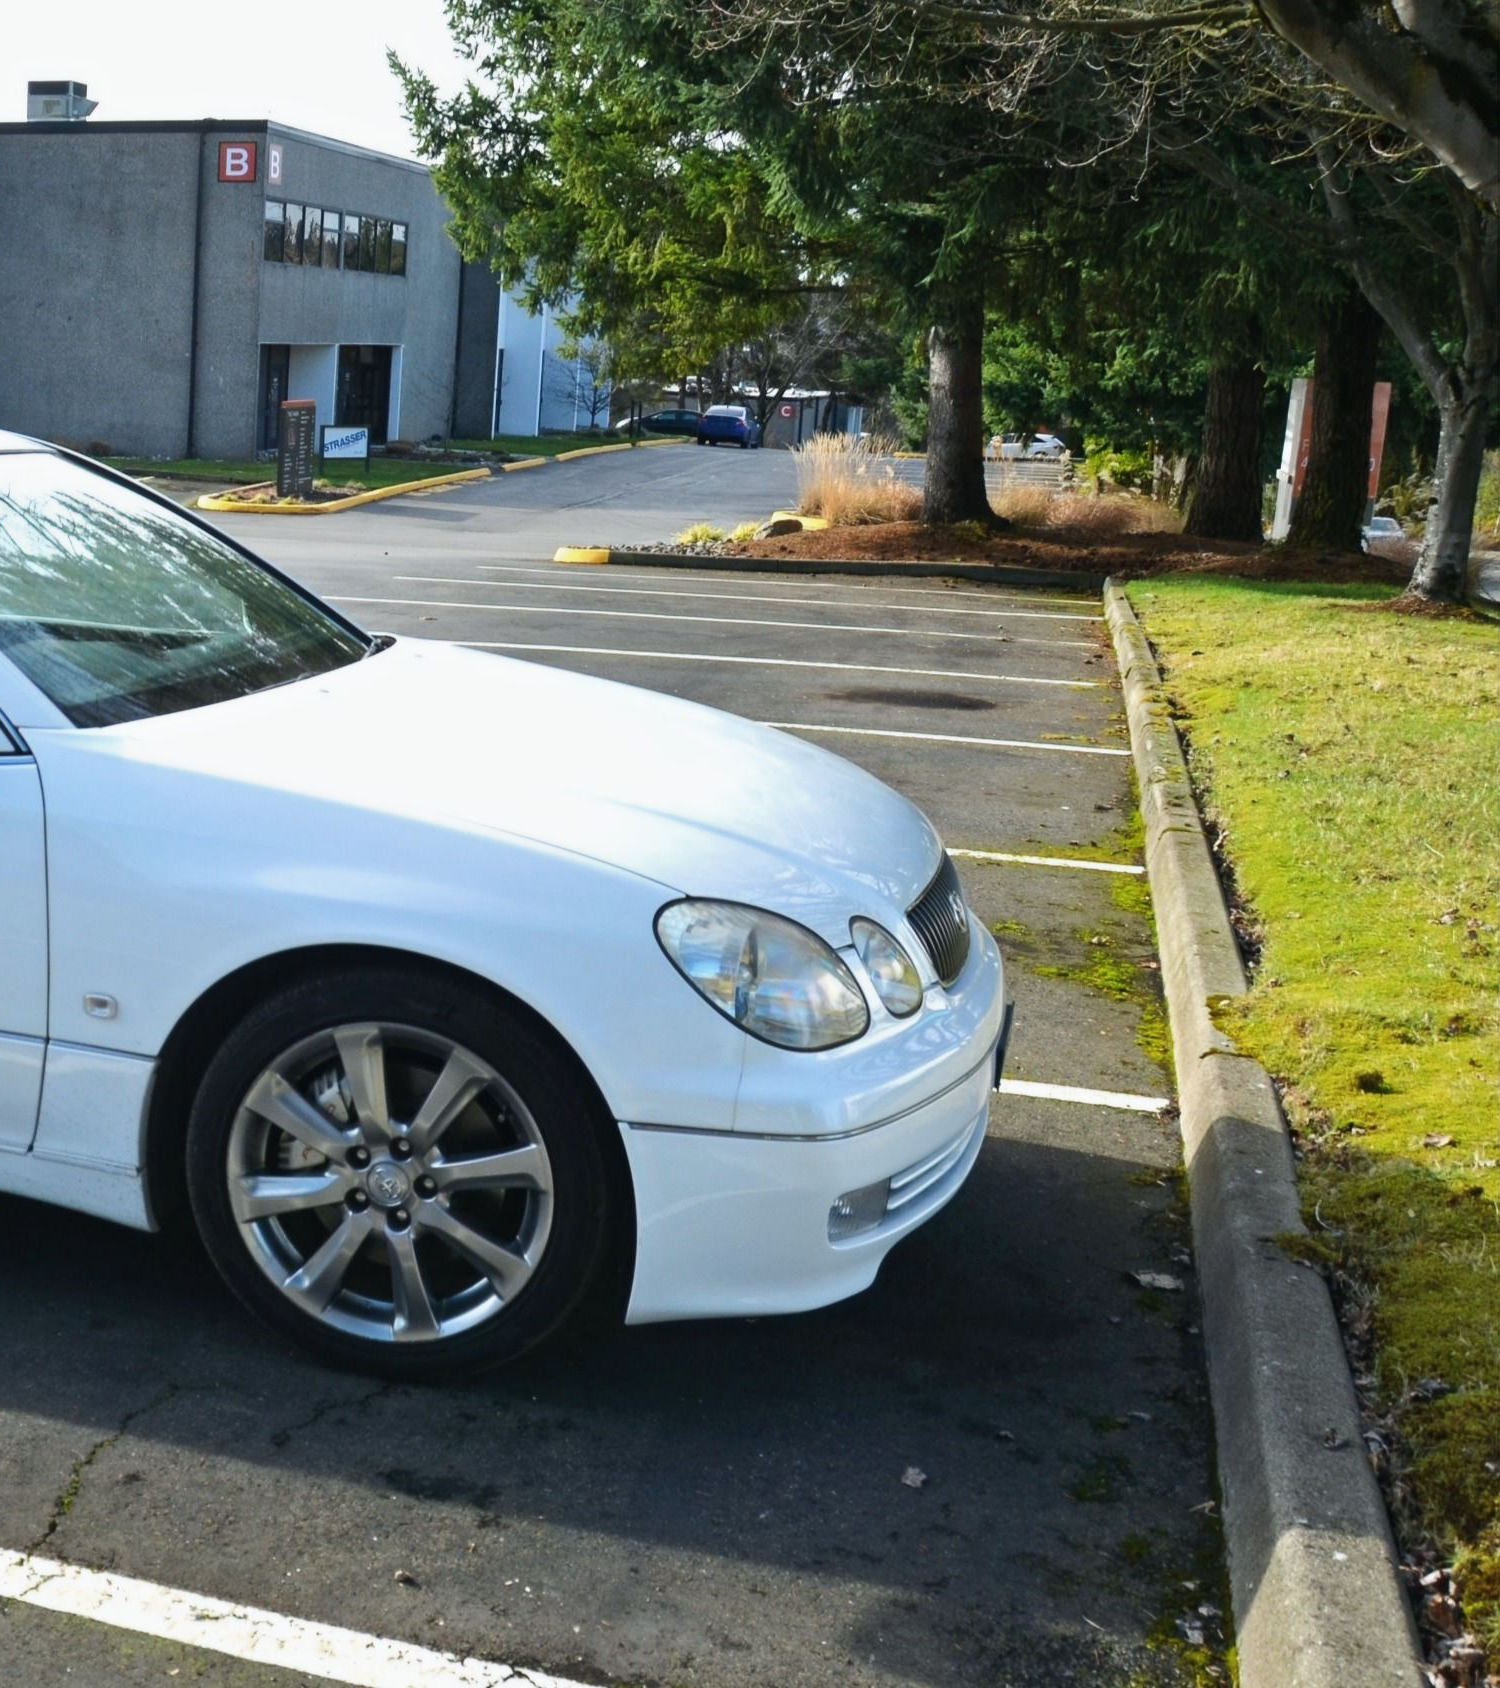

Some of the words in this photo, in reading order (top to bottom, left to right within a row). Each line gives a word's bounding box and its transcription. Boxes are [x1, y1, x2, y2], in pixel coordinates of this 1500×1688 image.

[225, 147, 249, 177] B
[270, 150, 280, 178] B
[780, 405, 792, 417] C
[323, 430, 367, 452] STRASSER
